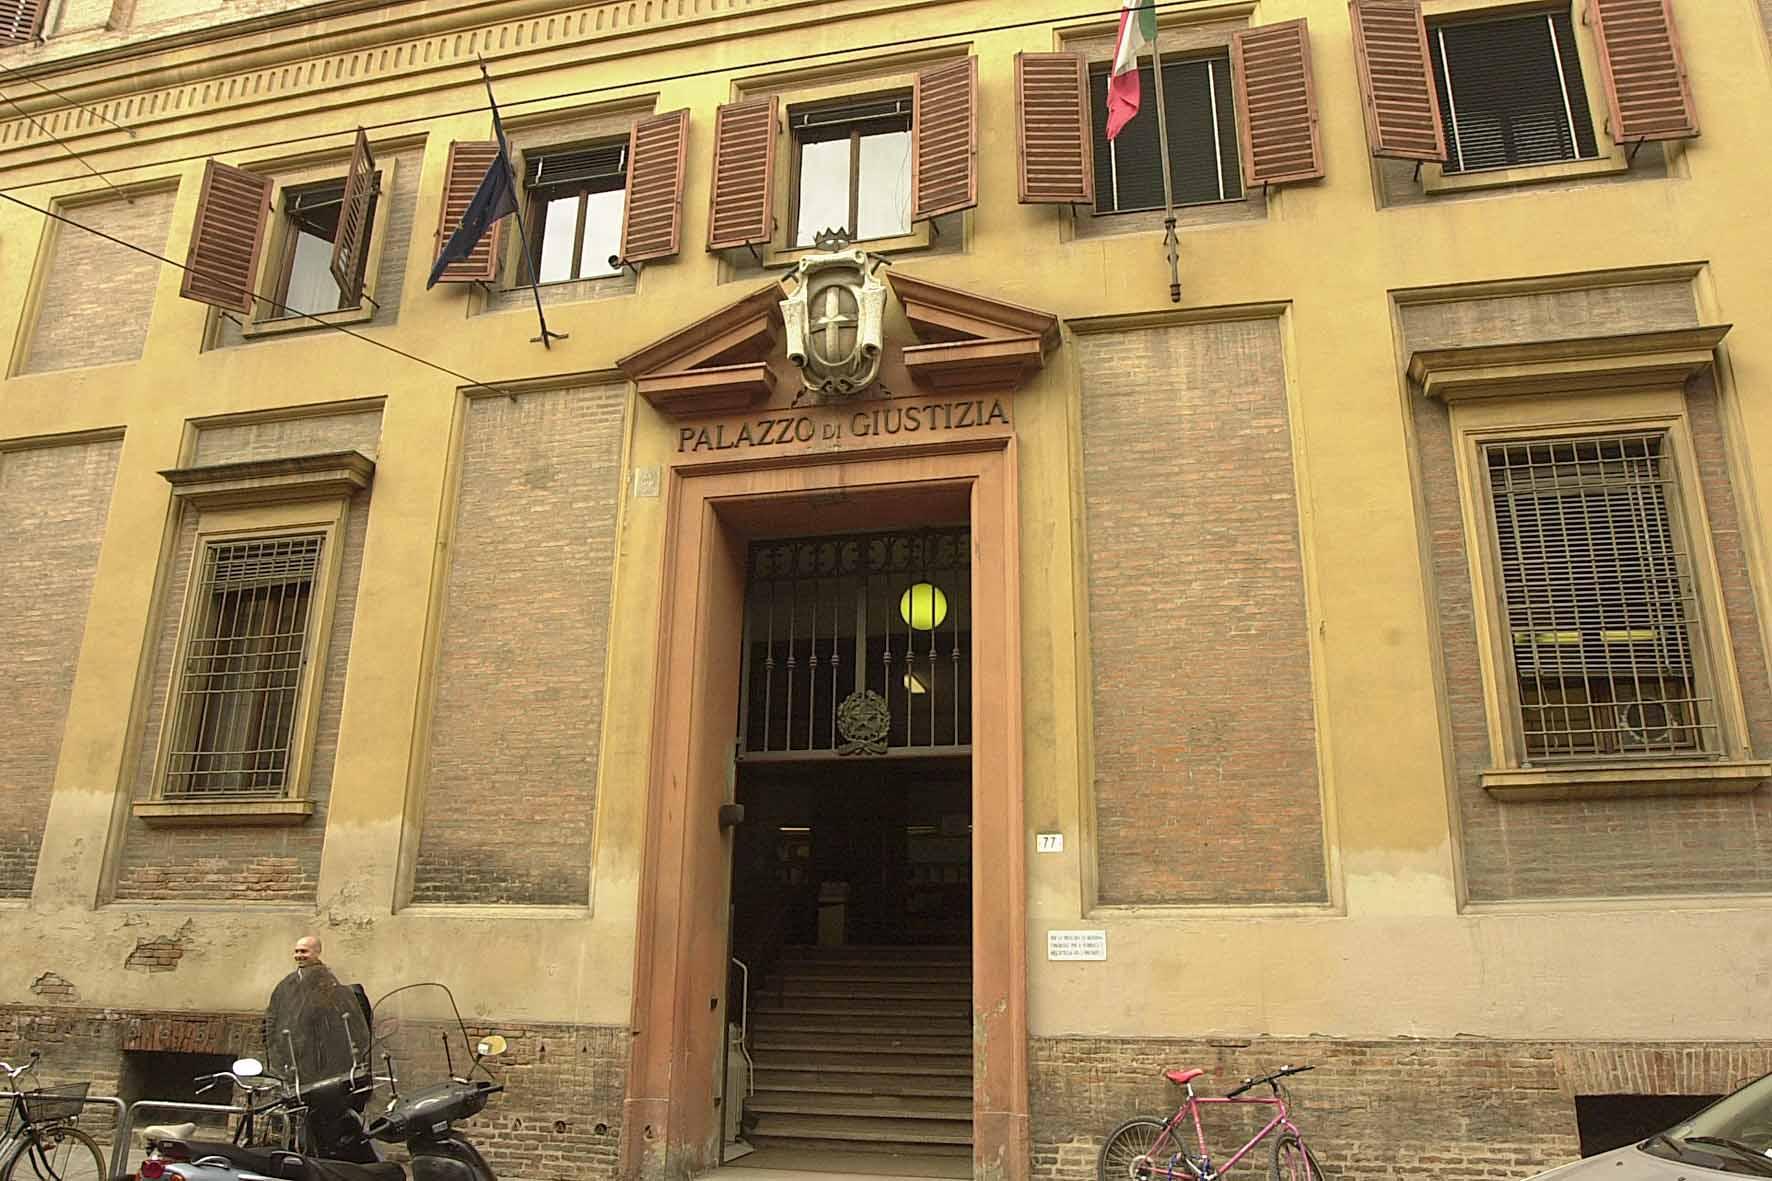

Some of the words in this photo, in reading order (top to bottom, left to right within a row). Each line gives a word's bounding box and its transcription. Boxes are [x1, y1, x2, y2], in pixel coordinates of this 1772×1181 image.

[677, 417, 816, 452] PALAZZO
[822, 423, 842, 440] DI
[850, 400, 1009, 437] GIUSTIZIA
[1042, 837, 1056, 848] 77
